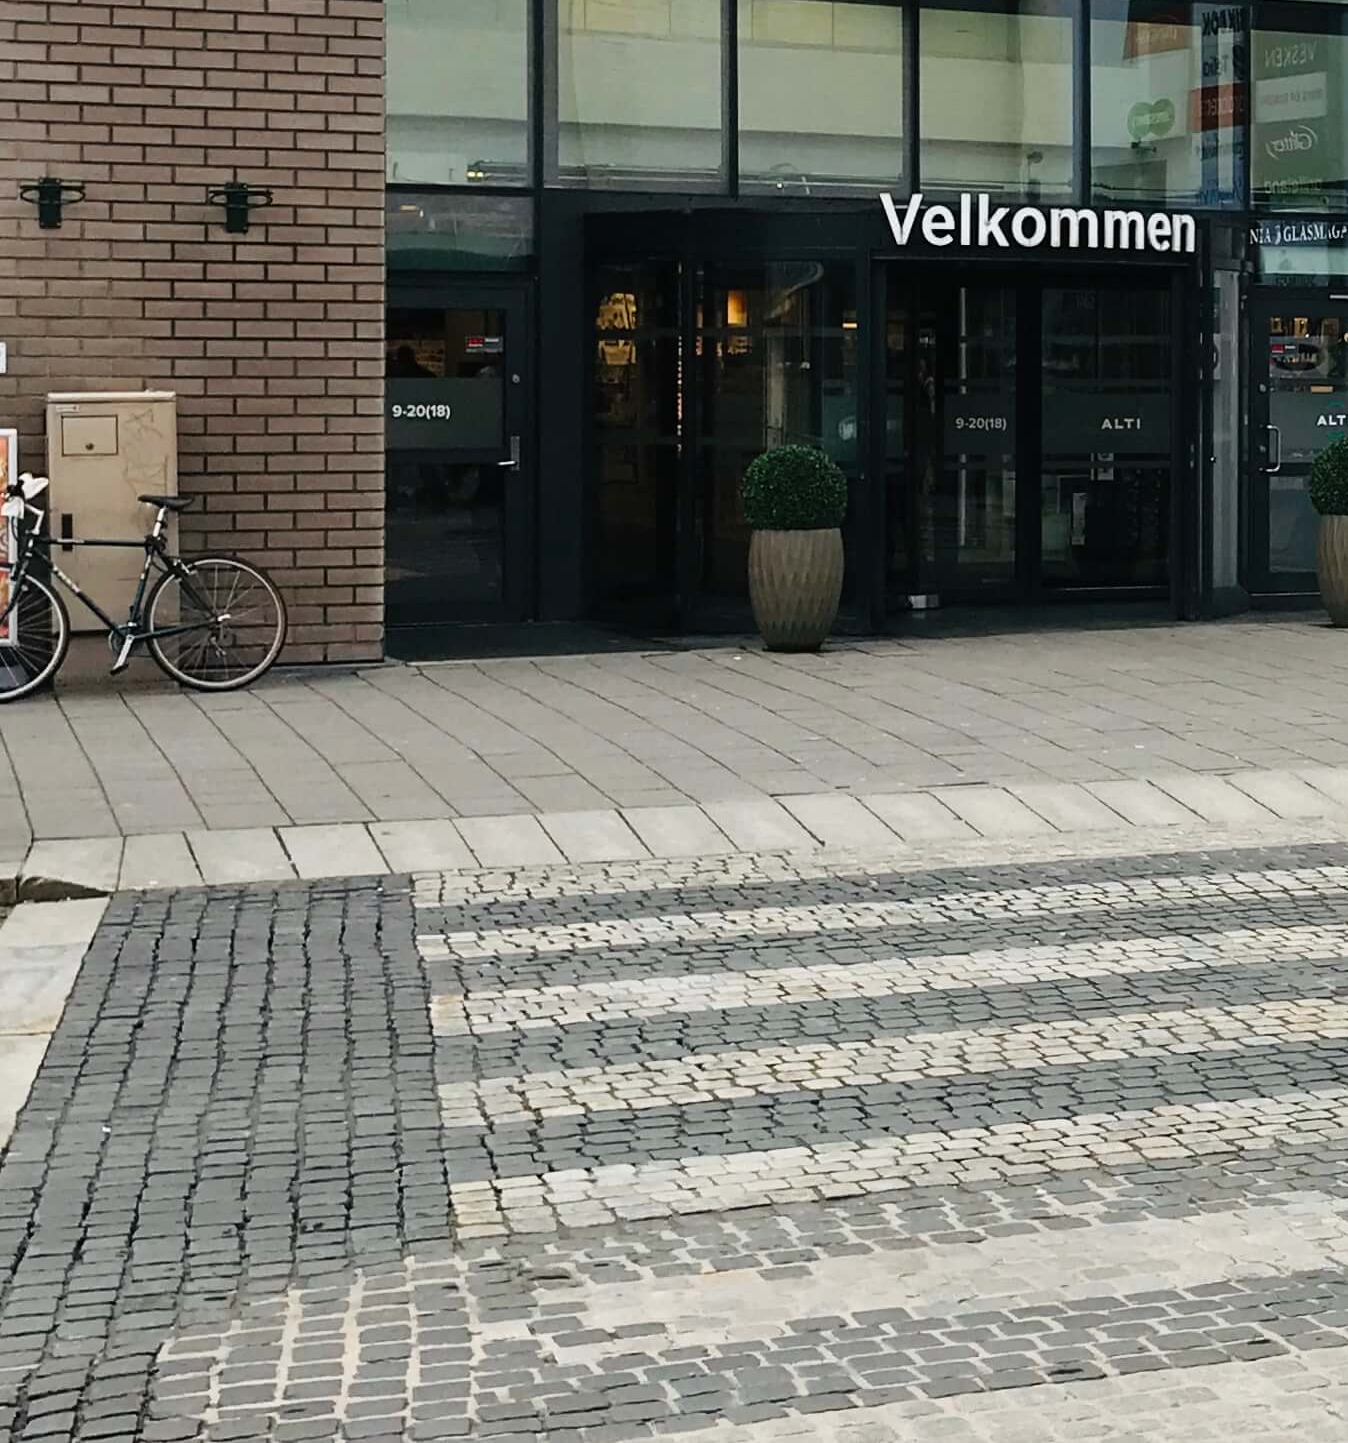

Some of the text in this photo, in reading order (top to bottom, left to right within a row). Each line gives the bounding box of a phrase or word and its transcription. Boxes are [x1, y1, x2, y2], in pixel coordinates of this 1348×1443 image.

[879, 193, 1196, 252] Velkommen
[392, 405, 451, 420] 9-20(18)
[956, 418, 1007, 430] 9-20(18)
[1101, 419, 1140, 429] ALTI
